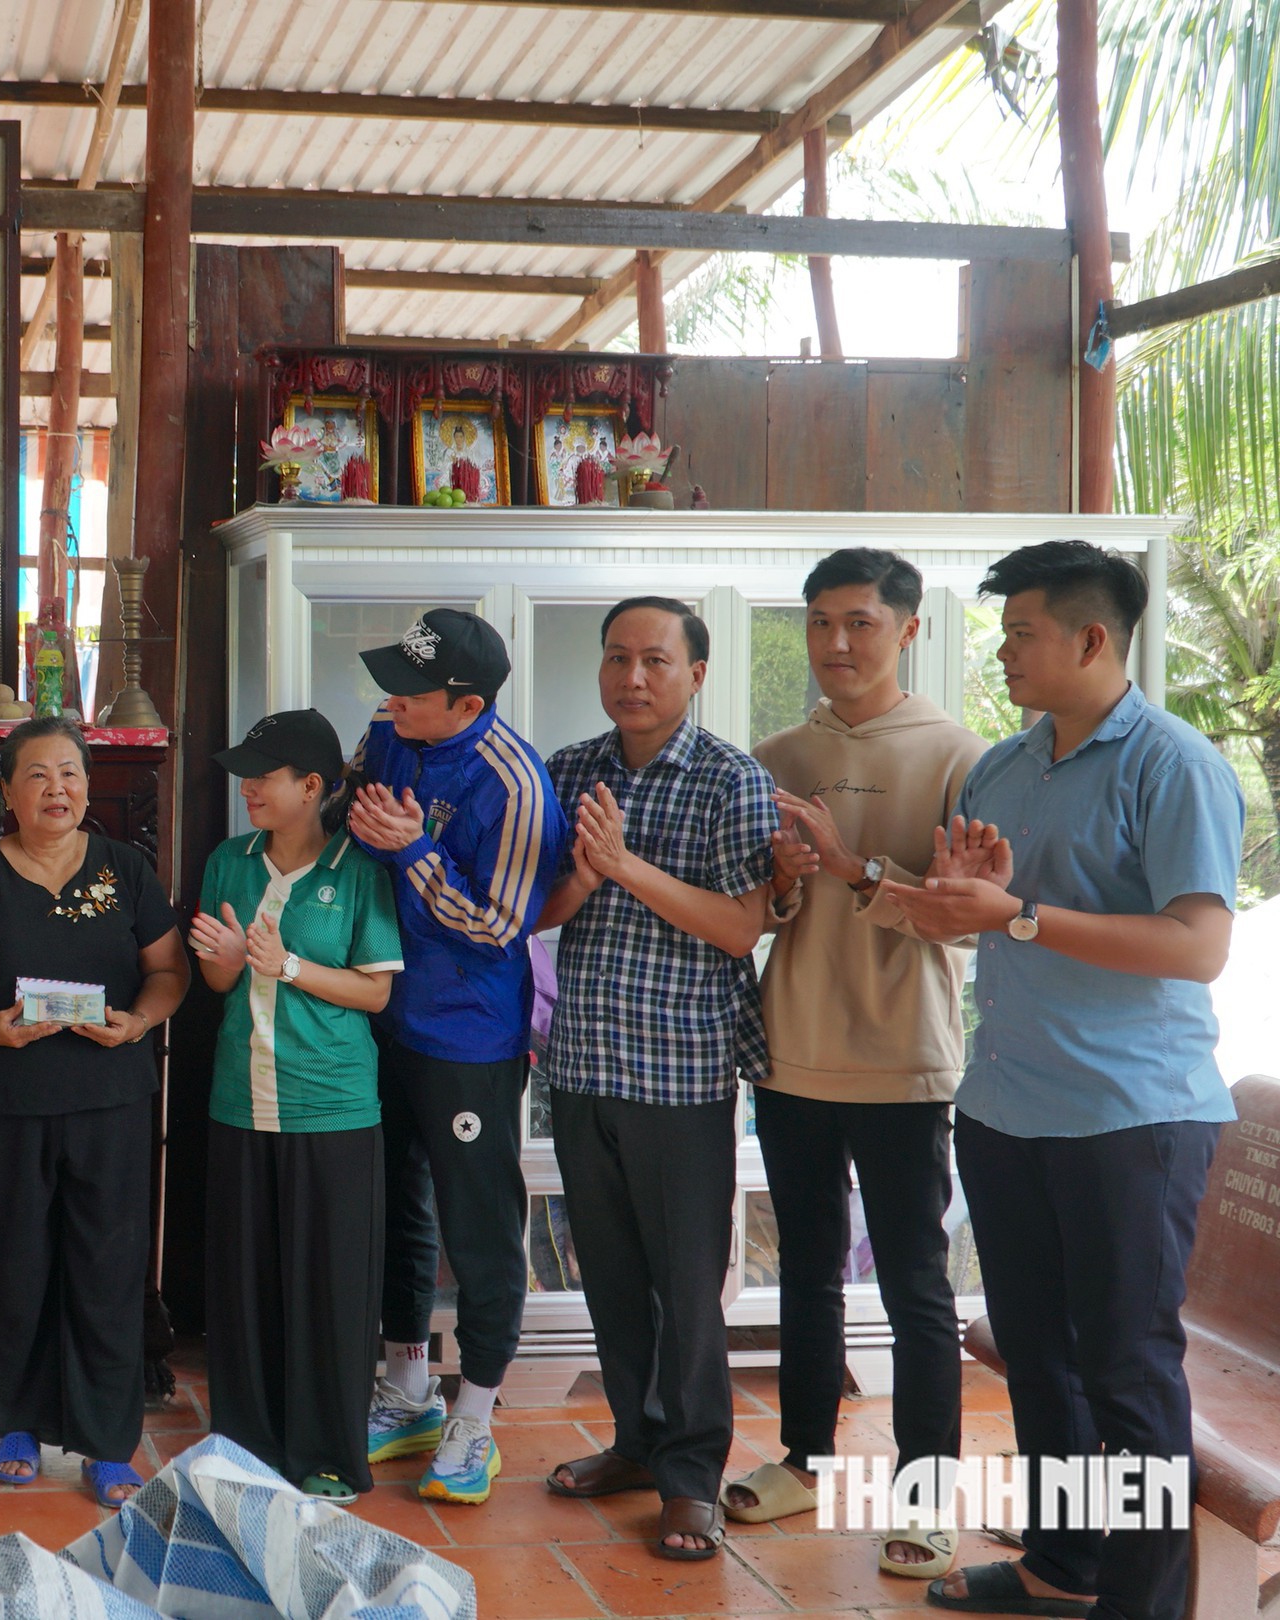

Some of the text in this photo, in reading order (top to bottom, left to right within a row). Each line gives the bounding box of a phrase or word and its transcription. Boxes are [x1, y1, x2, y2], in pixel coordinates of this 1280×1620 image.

[256, 1011, 270, 1076] Club
[1240, 1120, 1265, 1138] CTY
[1246, 1146, 1279, 1169] TMSX
[1239, 1206, 1274, 1235] 07803
